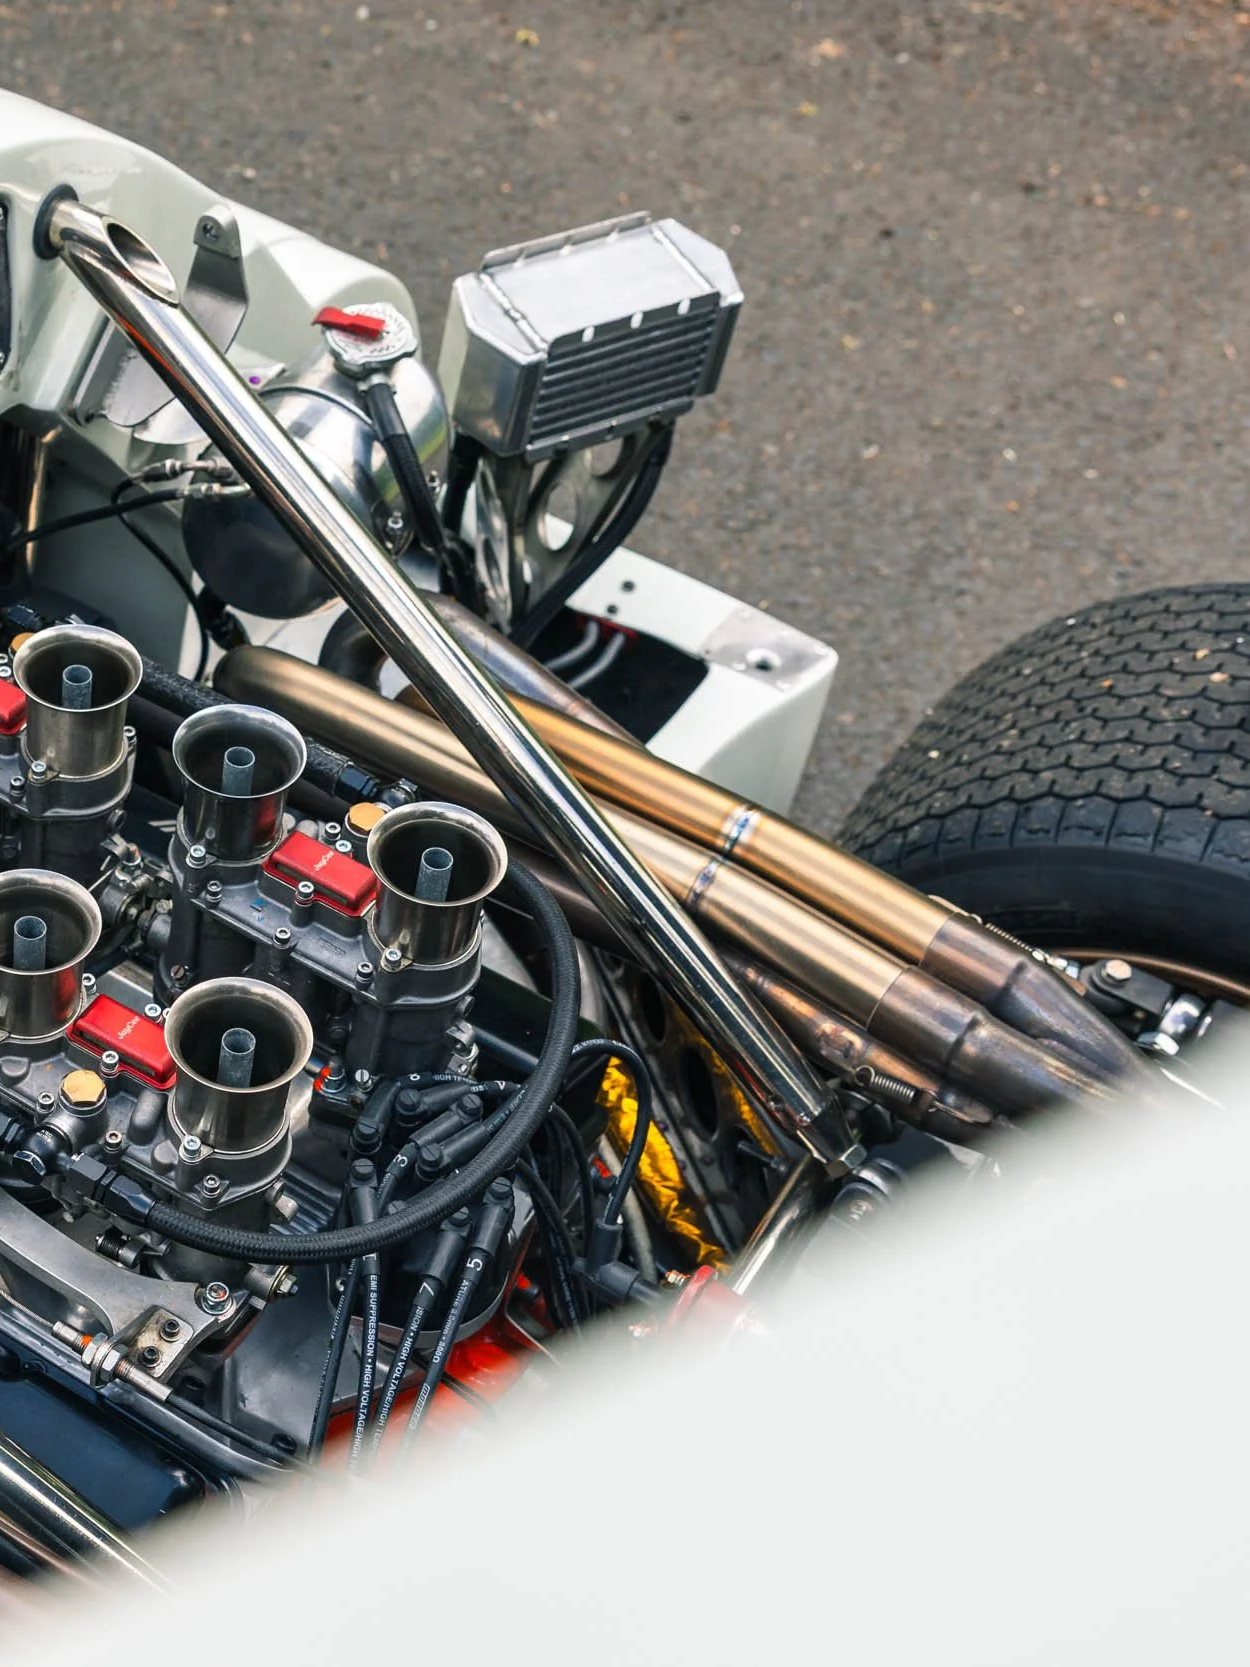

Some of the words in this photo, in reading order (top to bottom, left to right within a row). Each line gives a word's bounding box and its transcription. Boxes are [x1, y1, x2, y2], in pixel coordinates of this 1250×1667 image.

[117, 1015, 142, 1040] JayCee
[392, 1153, 408, 1168] 3
[466, 1257, 483, 1272] 5
[369, 1274, 378, 1292] EMI
[419, 1281, 435, 1297] 7
[364, 1292, 377, 1357] SUPPRESSION
[399, 1334, 414, 1362] HIGH
[362, 1363, 373, 1388] HIGH
[377, 1361, 406, 1426] VOLTAGE/HIGH
